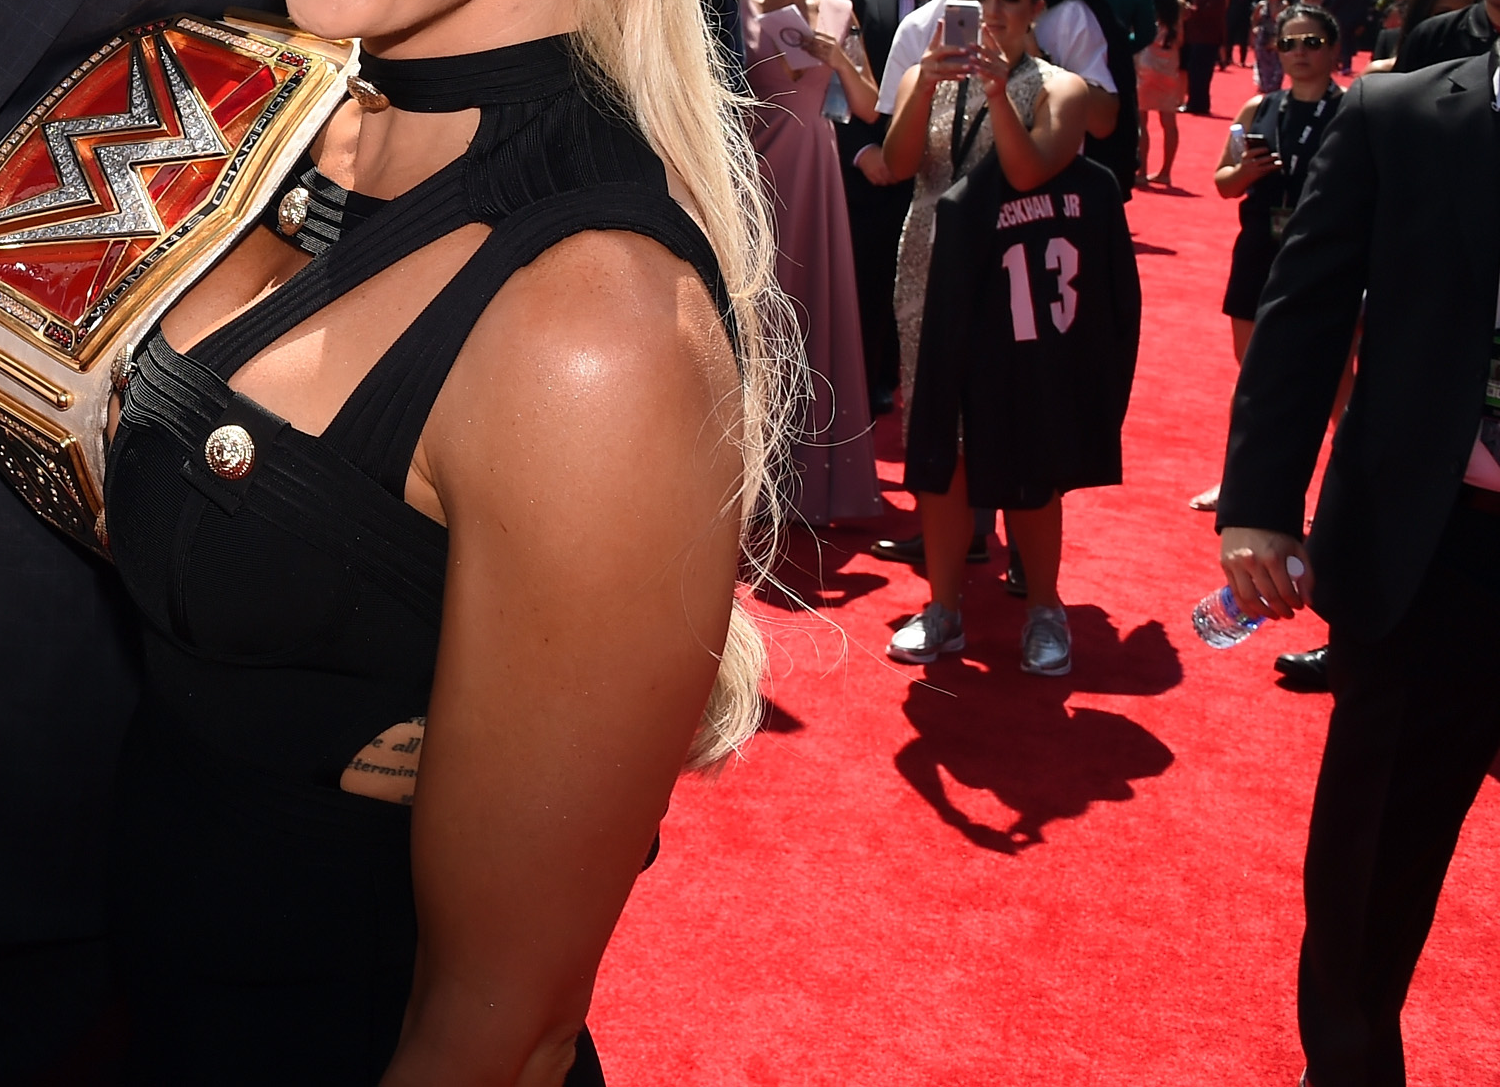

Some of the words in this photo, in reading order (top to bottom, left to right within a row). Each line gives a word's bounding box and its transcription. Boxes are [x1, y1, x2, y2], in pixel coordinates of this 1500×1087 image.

[211, 80, 298, 207] CHAMPION
[996, 194, 1055, 229] ECKHAM
[1063, 193, 1080, 217] JR
[1002, 237, 1079, 341] 13
